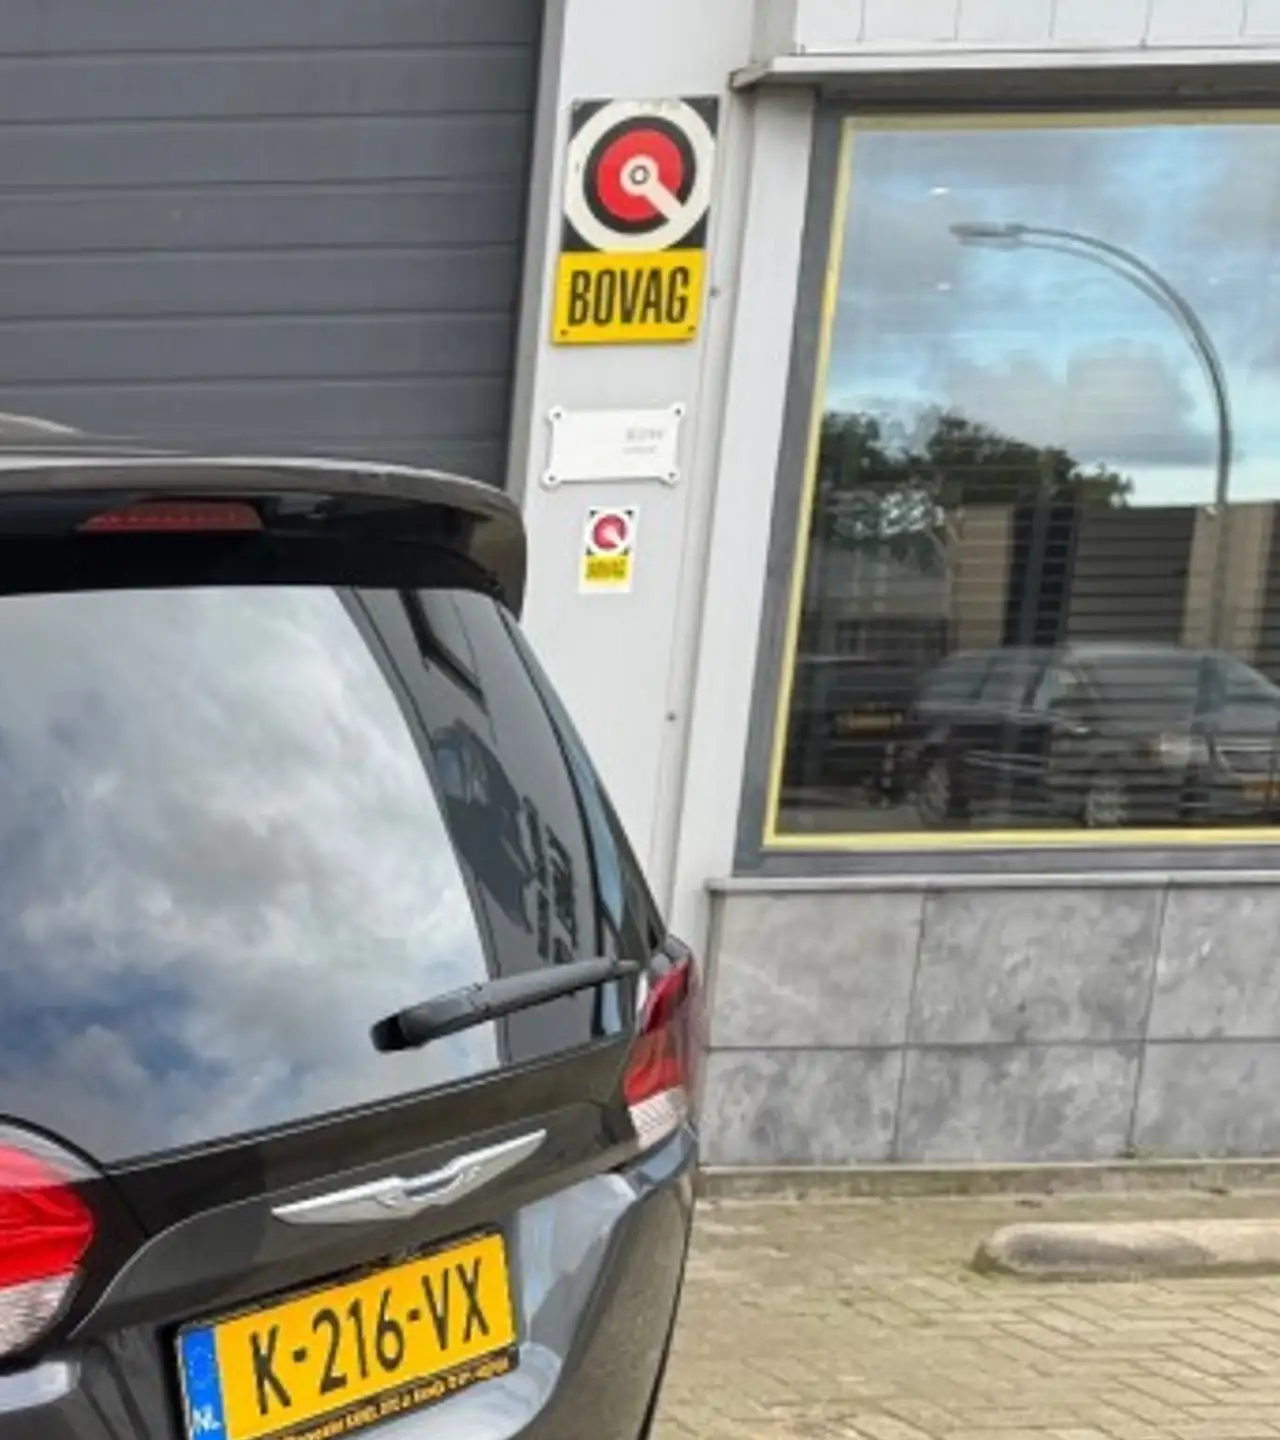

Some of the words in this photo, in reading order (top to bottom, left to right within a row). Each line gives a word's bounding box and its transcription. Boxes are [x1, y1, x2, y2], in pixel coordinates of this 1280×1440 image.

[567, 266, 690, 327] BOVAG
[248, 1255, 490, 1417] K-216-VX
[192, 1402, 221, 1436] NL
